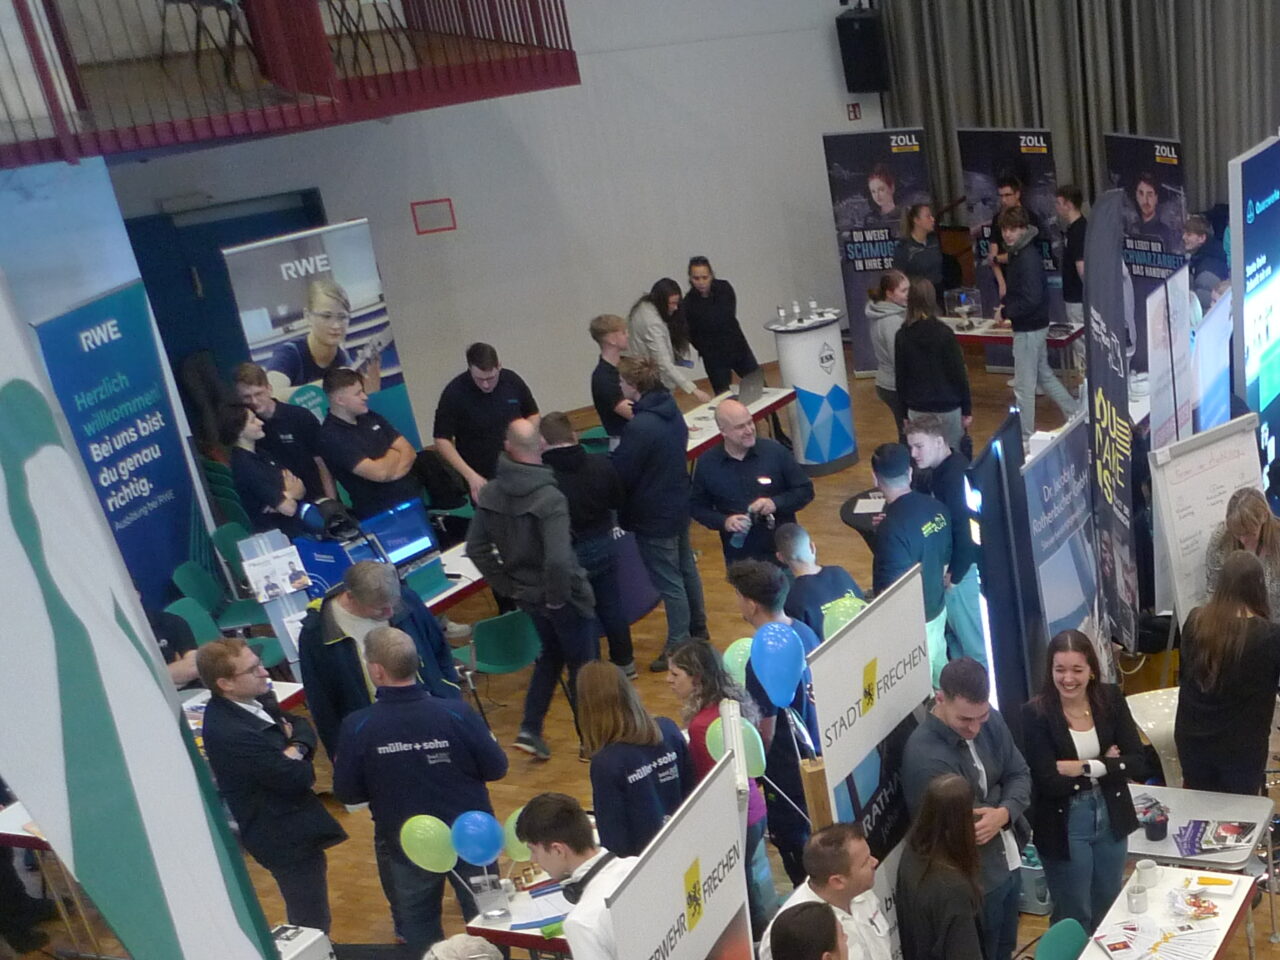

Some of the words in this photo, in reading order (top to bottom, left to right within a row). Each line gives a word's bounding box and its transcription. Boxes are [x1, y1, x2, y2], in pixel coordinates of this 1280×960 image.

[890, 135, 919, 147] ZOLL
[1020, 136, 1047, 147] ZOLL
[1155, 145, 1178, 158] ZOLL
[853, 231, 864, 242] DU
[865, 229, 889, 241] WEIST
[280, 253, 331, 281] RWE
[865, 258, 883, 270] IHRE
[1123, 250, 1184, 267] CHWARZARBEIT
[79, 319, 122, 352] RWE
[73, 372, 130, 412] Herzlich
[89, 440, 114, 463] Bei
[114, 424, 138, 448] uns
[139, 410, 166, 437] bist
[99, 467, 119, 488] du
[118, 443, 162, 480] genau
[107, 477, 154, 512] richtig.
[824, 699, 862, 748] STADT
[876, 641, 927, 700] FRECHEN
[377, 742, 413, 754] müller
[422, 739, 449, 750] sohn
[702, 841, 740, 903] FRECHEN
